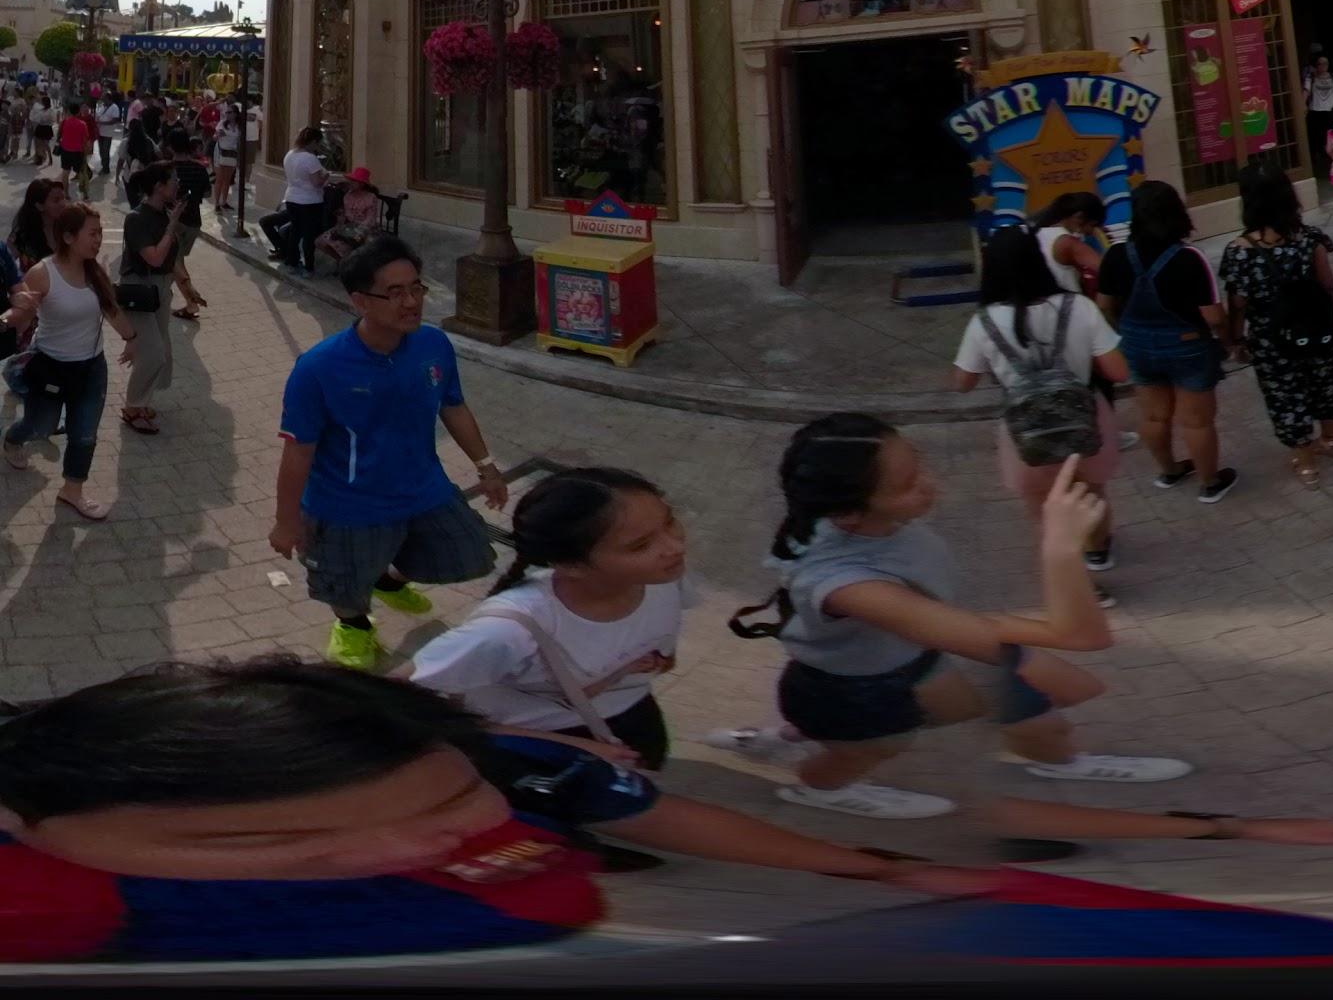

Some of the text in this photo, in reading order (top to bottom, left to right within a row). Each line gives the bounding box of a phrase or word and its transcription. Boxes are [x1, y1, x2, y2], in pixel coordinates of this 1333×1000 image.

[950, 77, 1157, 144] STAR MAPS
[576, 220, 643, 236] INQUISITOR
